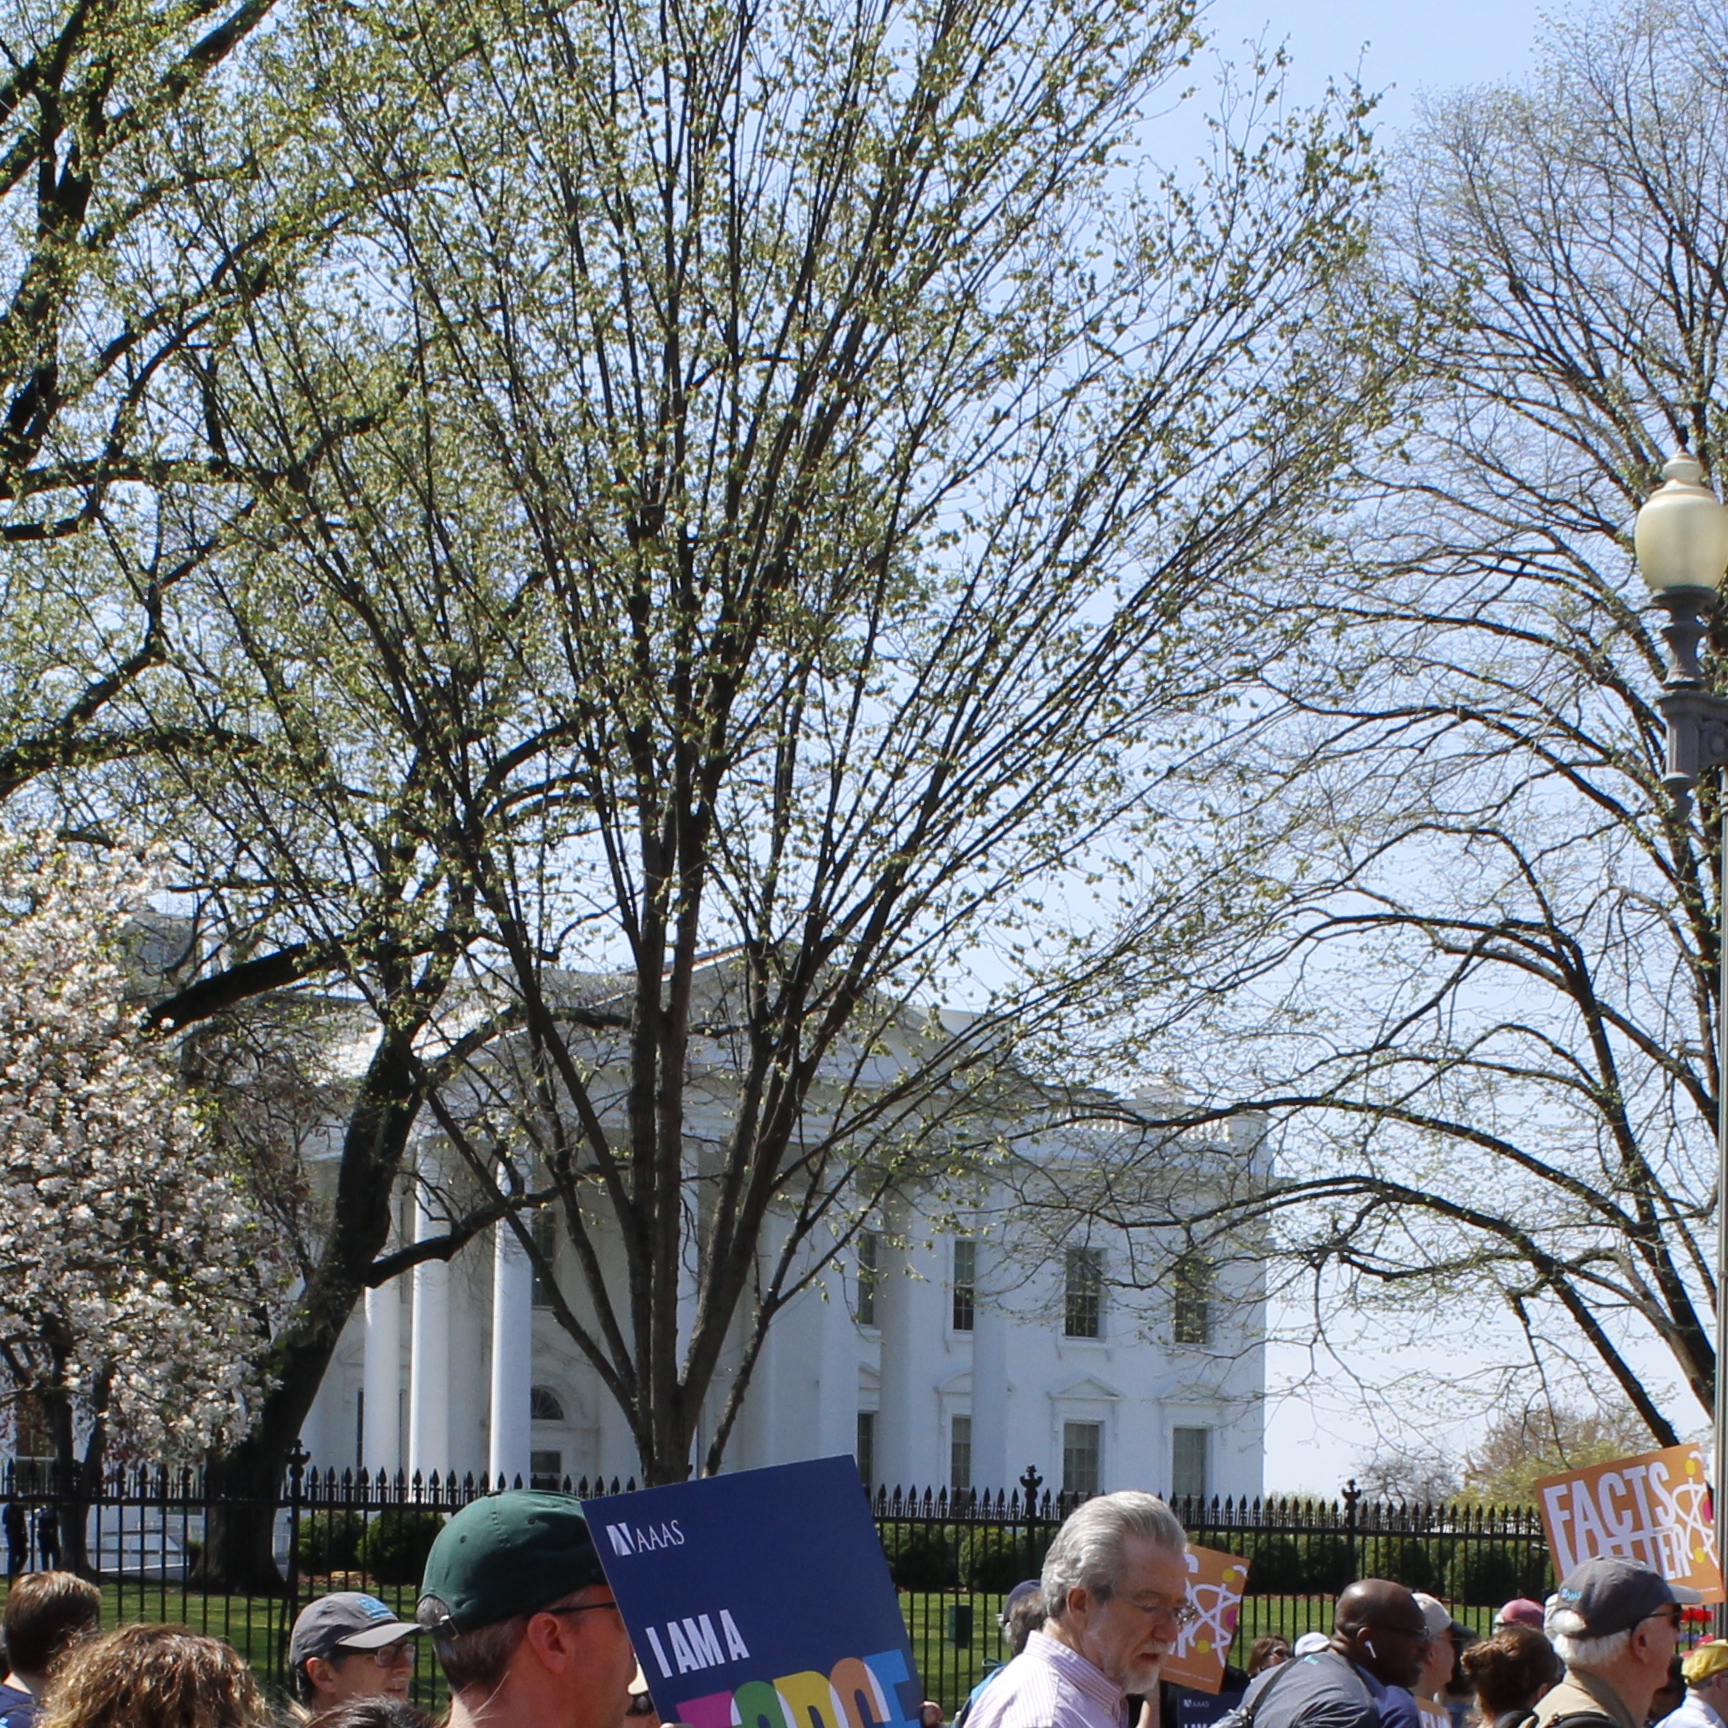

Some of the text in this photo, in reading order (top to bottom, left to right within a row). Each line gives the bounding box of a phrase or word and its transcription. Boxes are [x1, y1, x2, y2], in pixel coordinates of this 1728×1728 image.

[636, 1520, 685, 1553] AAAS
[1543, 1461, 1677, 1550] FACTS
[645, 1608, 750, 1679] I AM A
